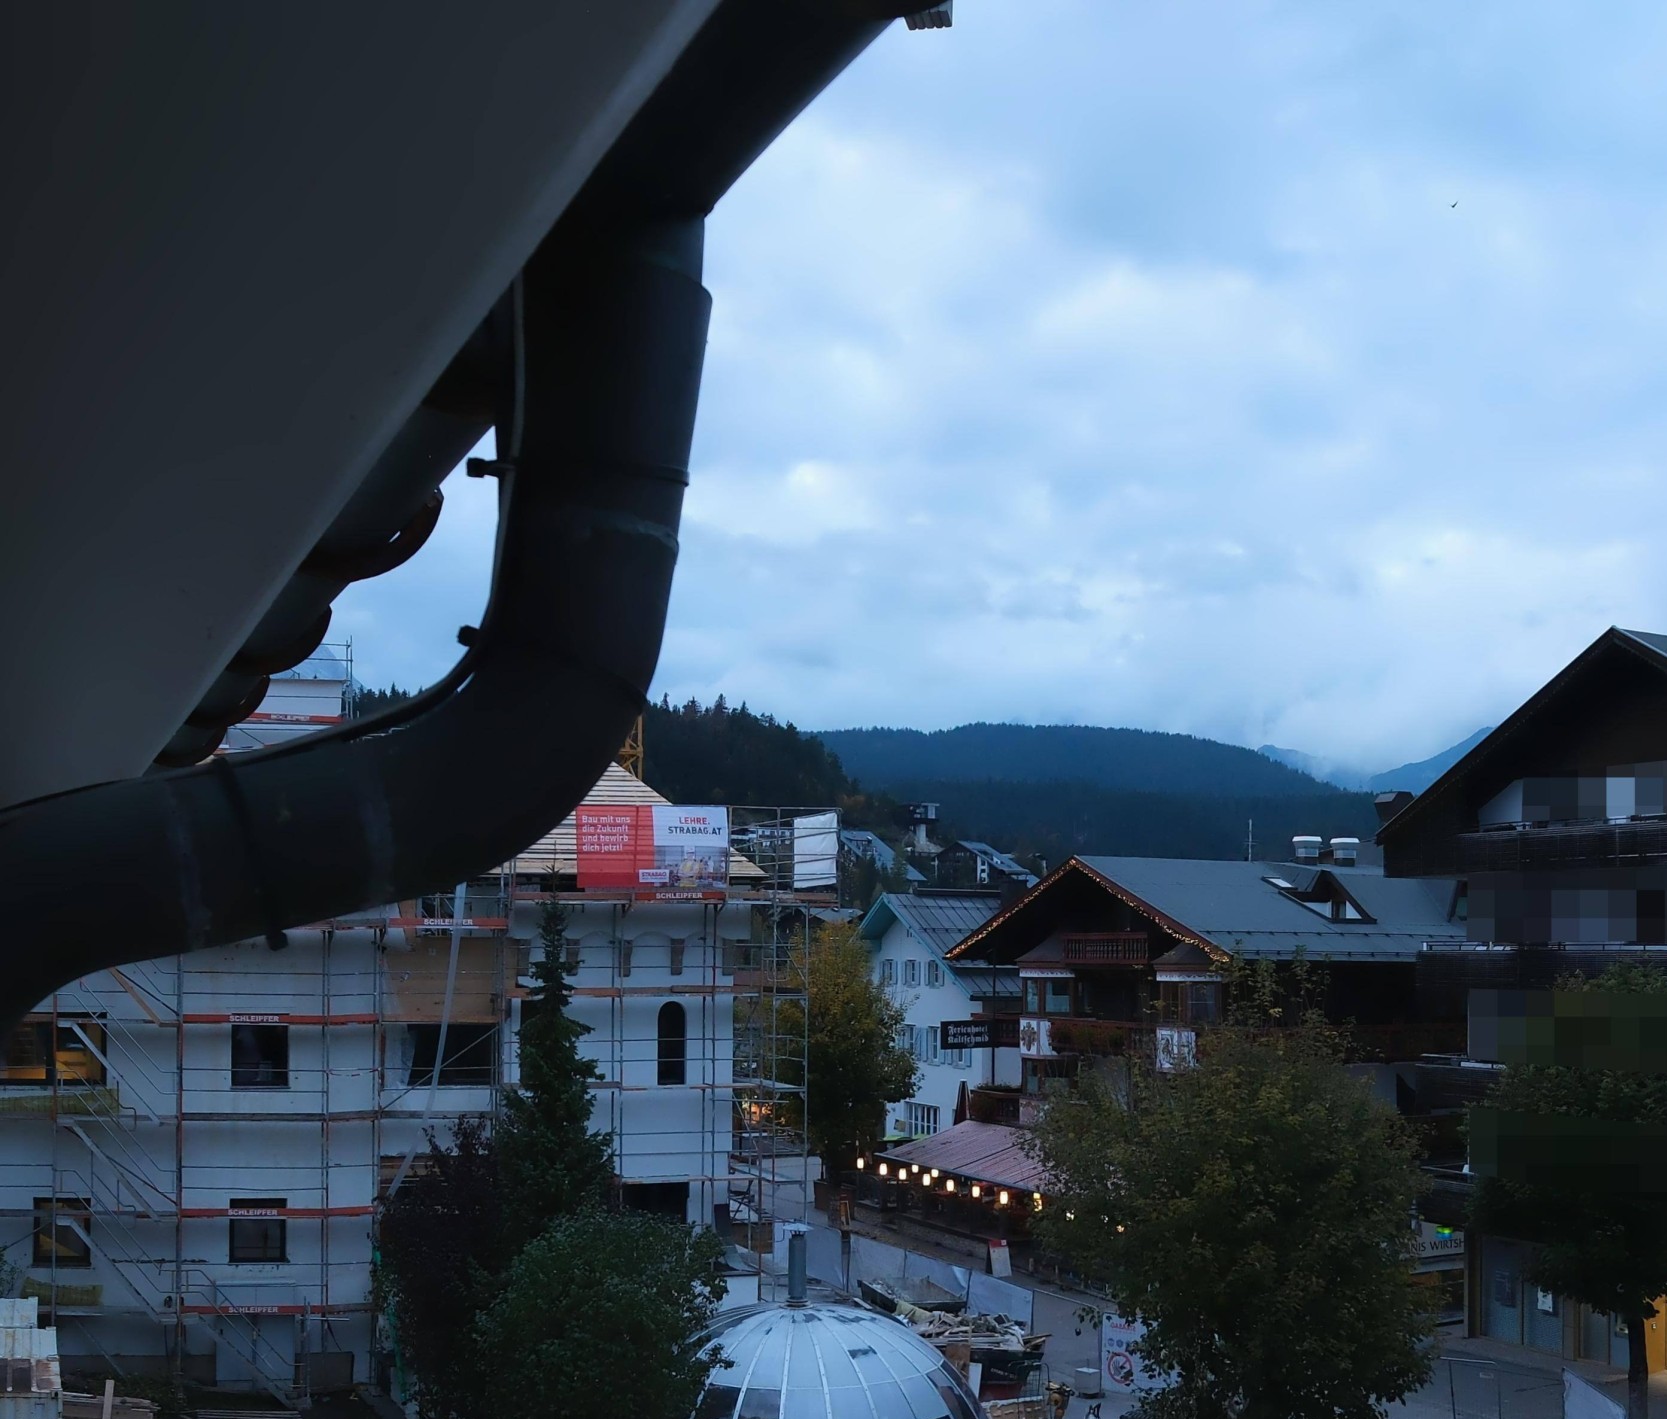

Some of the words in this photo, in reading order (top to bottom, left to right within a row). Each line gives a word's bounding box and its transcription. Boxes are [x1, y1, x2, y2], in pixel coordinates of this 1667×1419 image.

[679, 817, 710, 825] LEHRE.
[668, 827, 721, 835] STRABAG.AT
[601, 844, 623, 852] jetzt!
